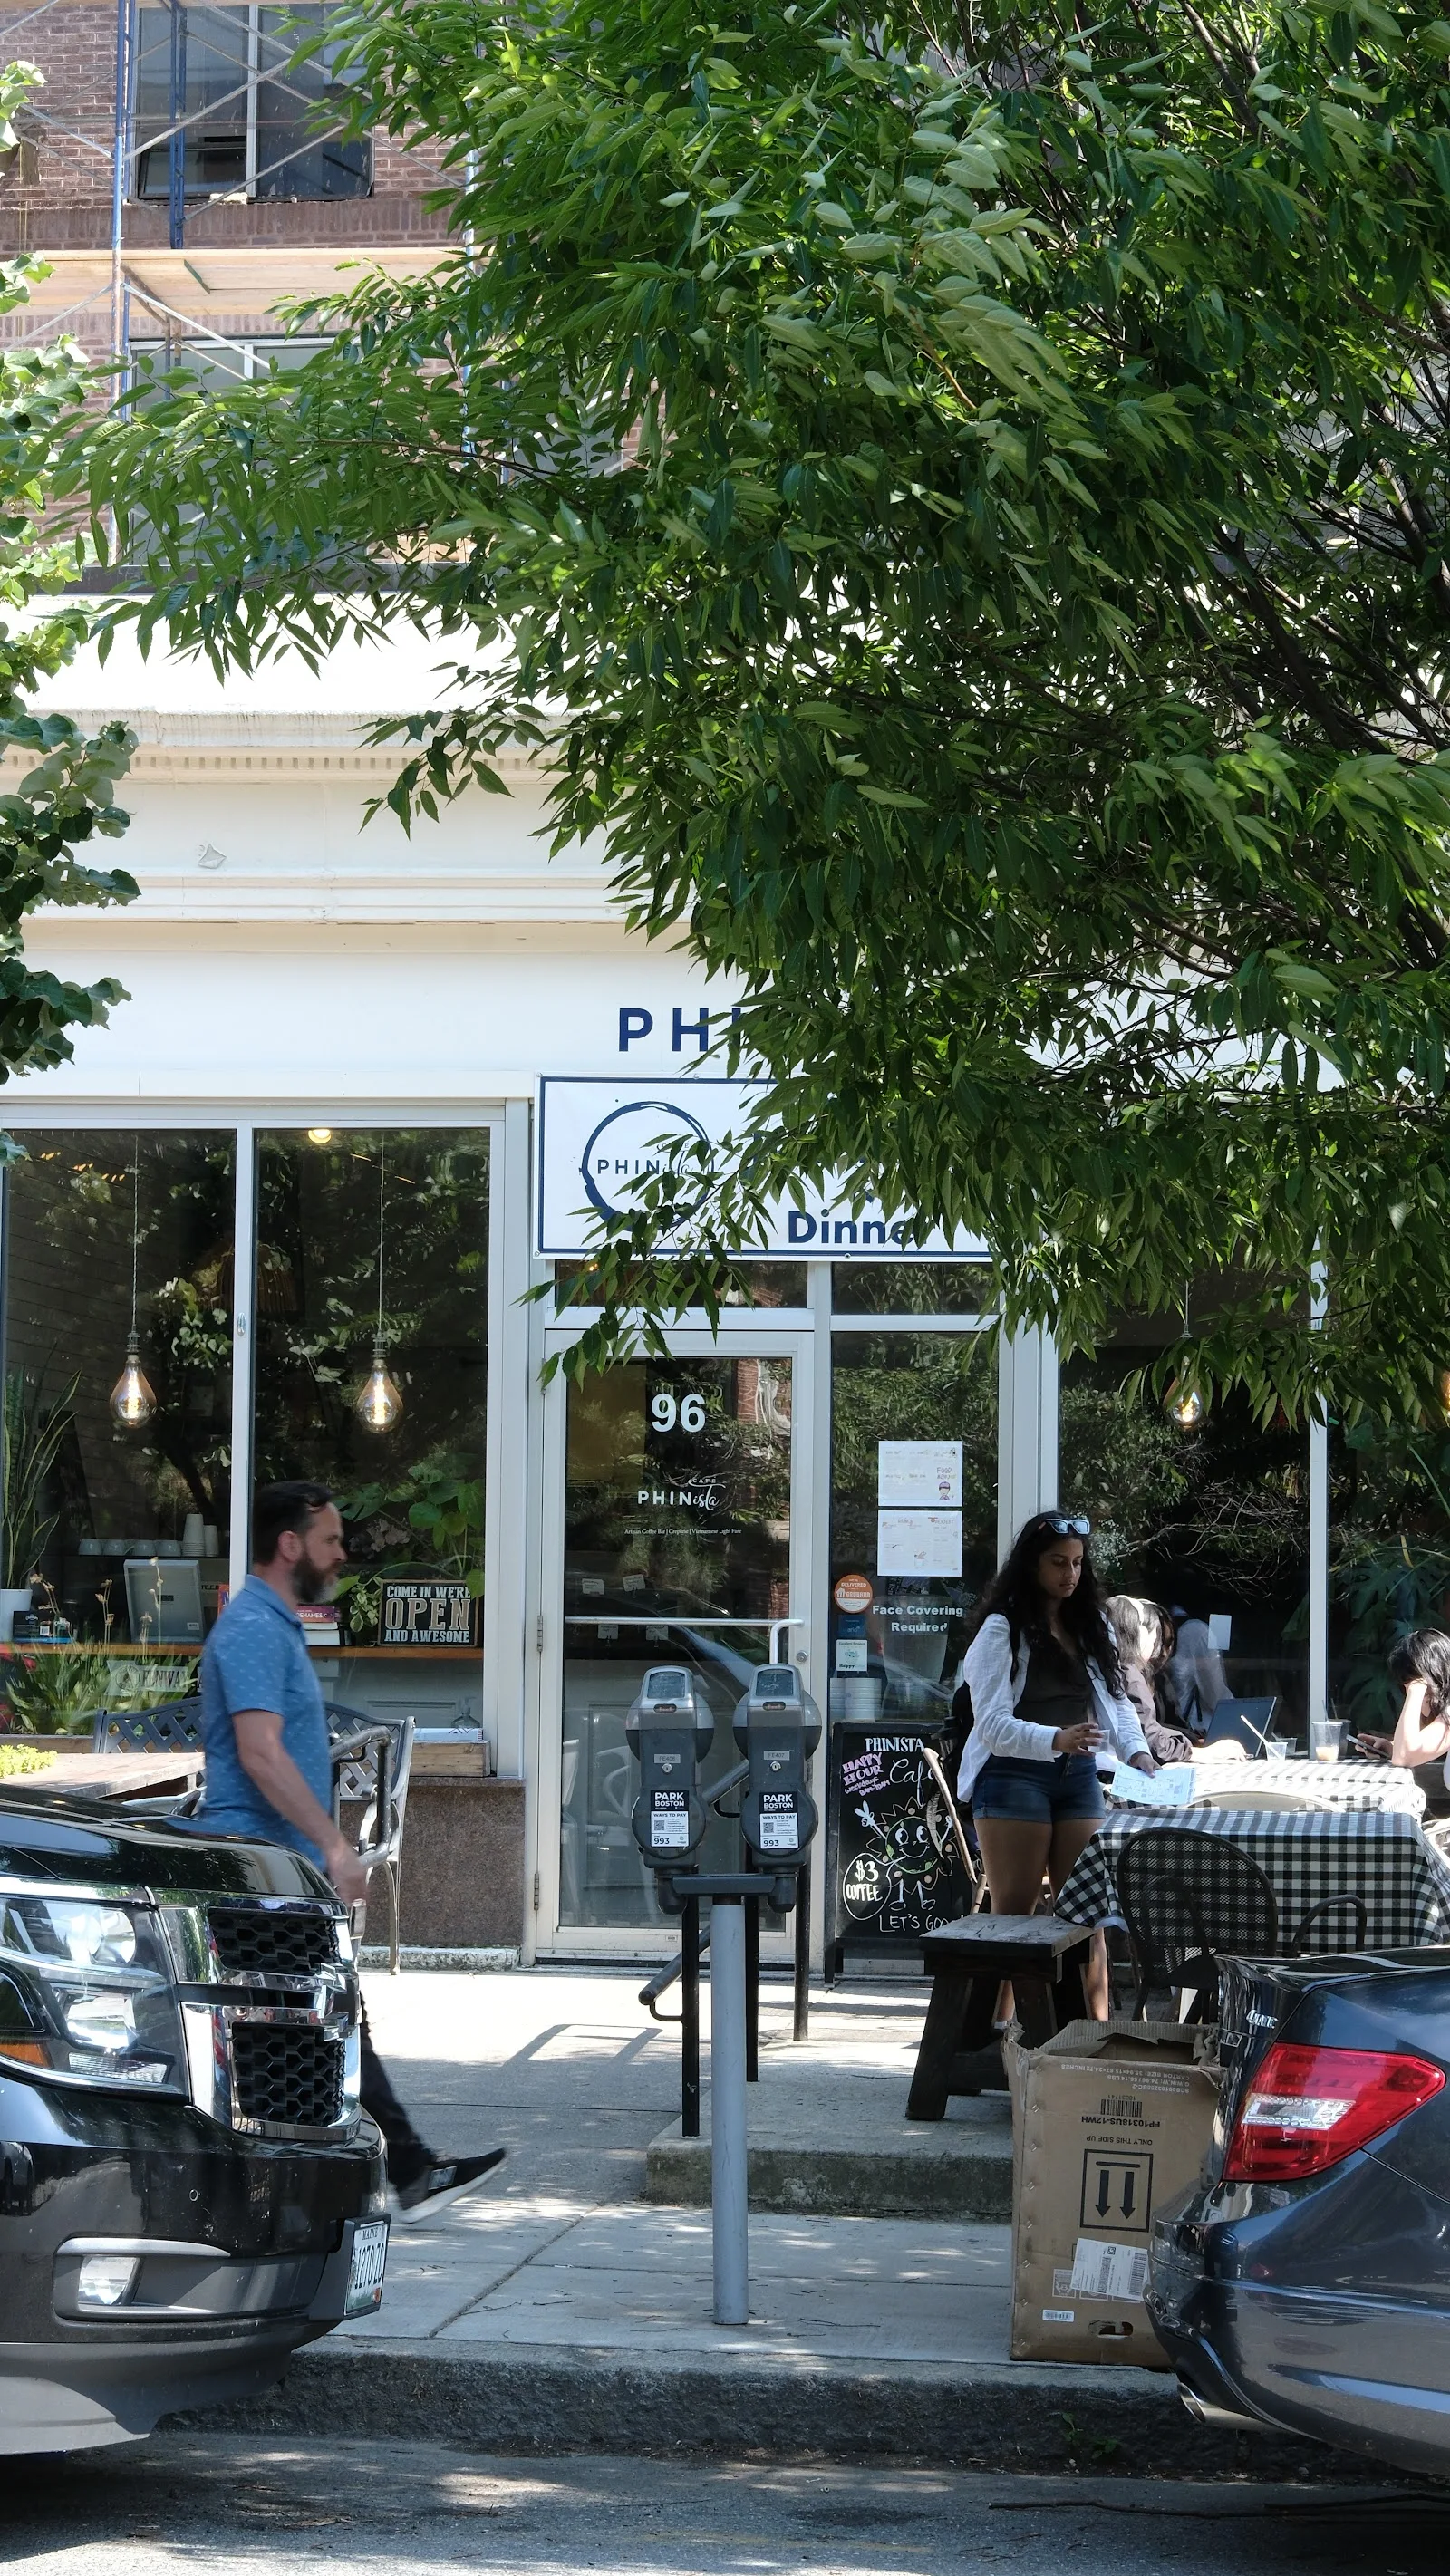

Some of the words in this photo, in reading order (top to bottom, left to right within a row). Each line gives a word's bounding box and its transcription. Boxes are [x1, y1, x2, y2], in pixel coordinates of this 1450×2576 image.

[619, 1008, 741, 1052] PH
[788, 1209, 927, 1245] Dinne
[651, 1393, 706, 1433] 96
[386, 1585, 418, 1598] COME
[420, 1586, 432, 1598] IN
[435, 1586, 471, 1599] WE'RE
[385, 1597, 471, 1631] OPEN
[872, 1605, 904, 1615] Face
[906, 1605, 963, 1617] Covering
[891, 1622, 948, 1634] Required
[384, 1629, 409, 1642] AND
[411, 1629, 469, 1643] AWESOME
[865, 1736, 924, 1752] PHINISTA
[842, 1752, 883, 1774] HAPPY
[842, 1764, 884, 1787] HOUR
[654, 1791, 684, 1801] PARK
[763, 1793, 793, 1803] PARK
[855, 1859, 879, 1882] $3
[846, 1883, 884, 1902] COFFEE
[879, 1913, 921, 1933] LET'S
[1061, 2062, 1086, 2071] INCHES
[1163, 2072, 1190, 2081] CARTON
[1081, 2116, 1161, 2128] FP10318US-12WH
[1116, 2137, 1132, 2145] THIS
[1133, 2137, 1153, 2146] ONLY
[362, 2227, 379, 2240] MAINE
